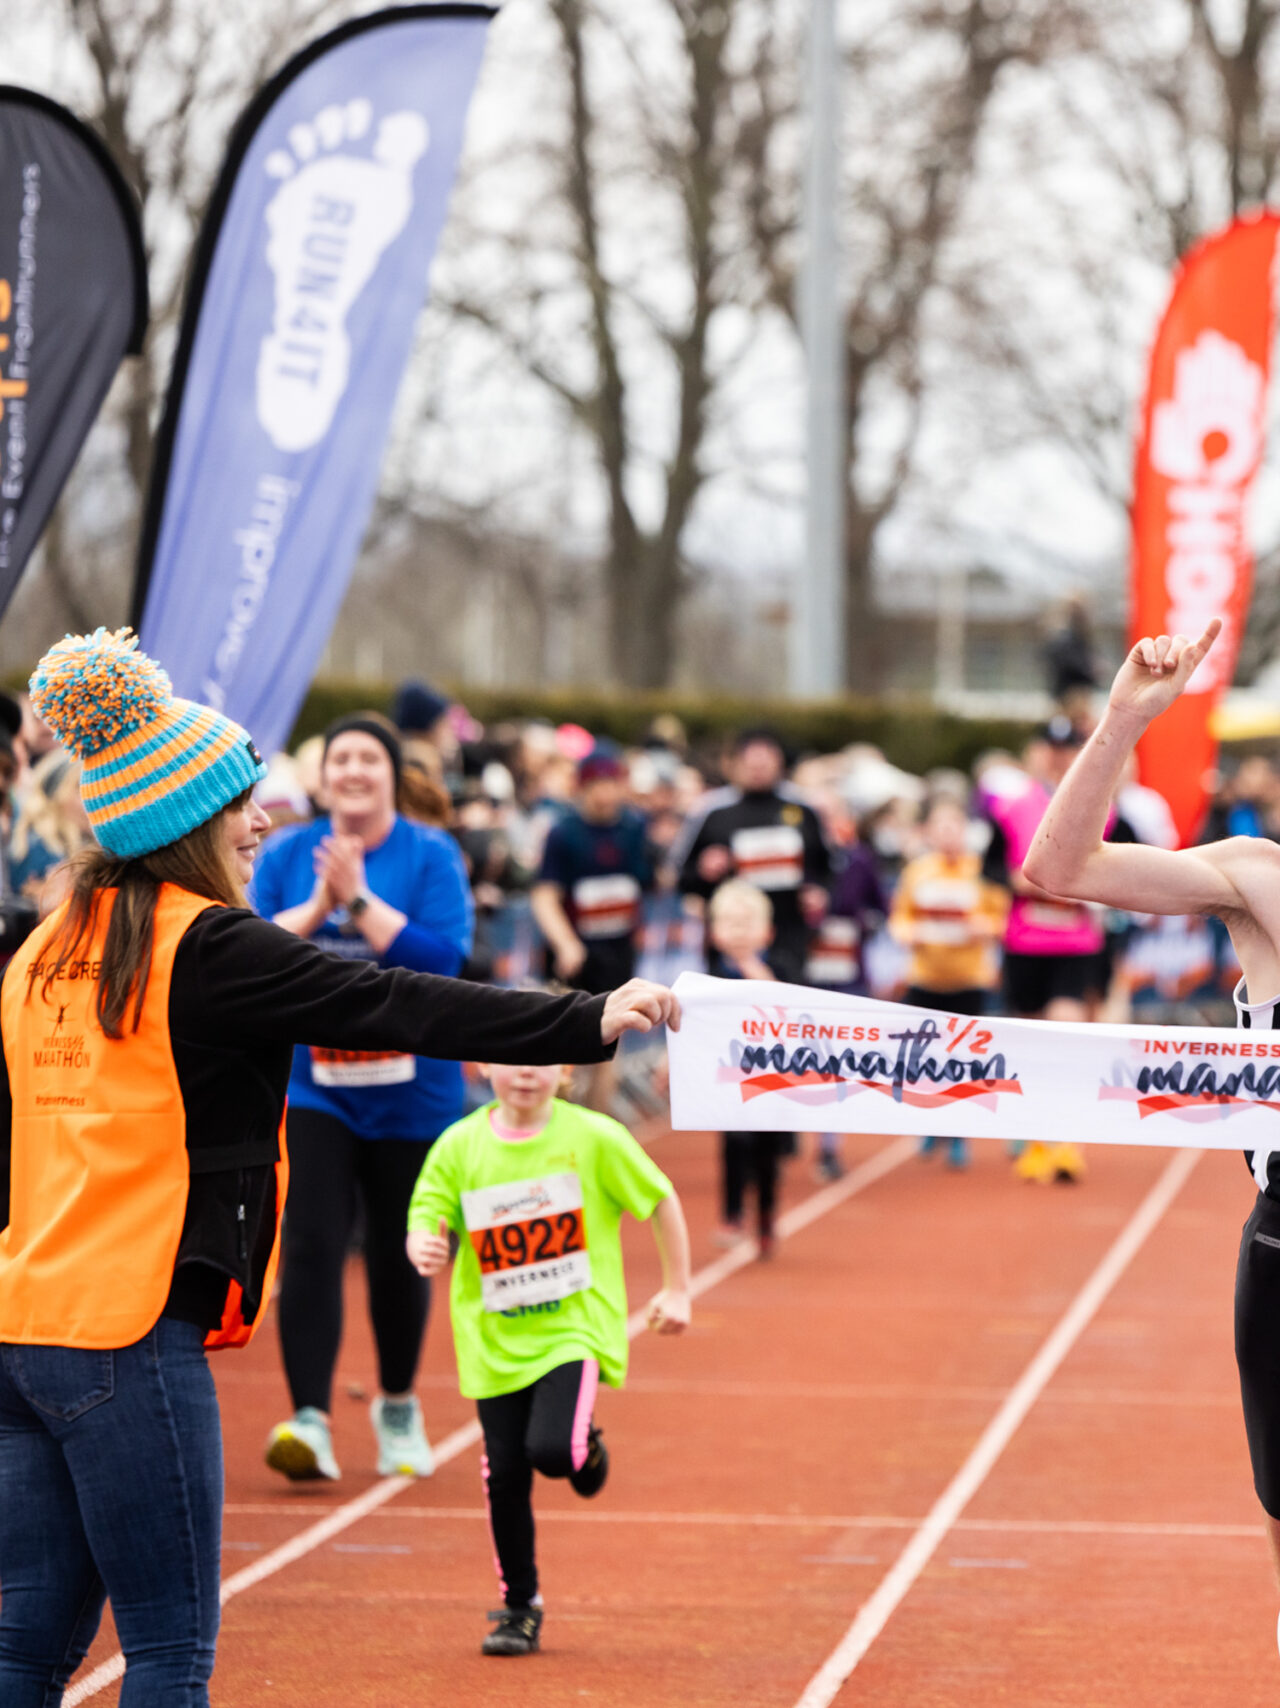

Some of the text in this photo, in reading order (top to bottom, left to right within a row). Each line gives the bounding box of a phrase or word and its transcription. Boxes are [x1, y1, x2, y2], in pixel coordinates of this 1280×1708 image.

[277, 193, 355, 390] RUN4IT
[740, 1018, 1018, 1103] marathon
[742, 1019, 881, 1042] INVERNESS
[478, 1211, 581, 1272] 4922
